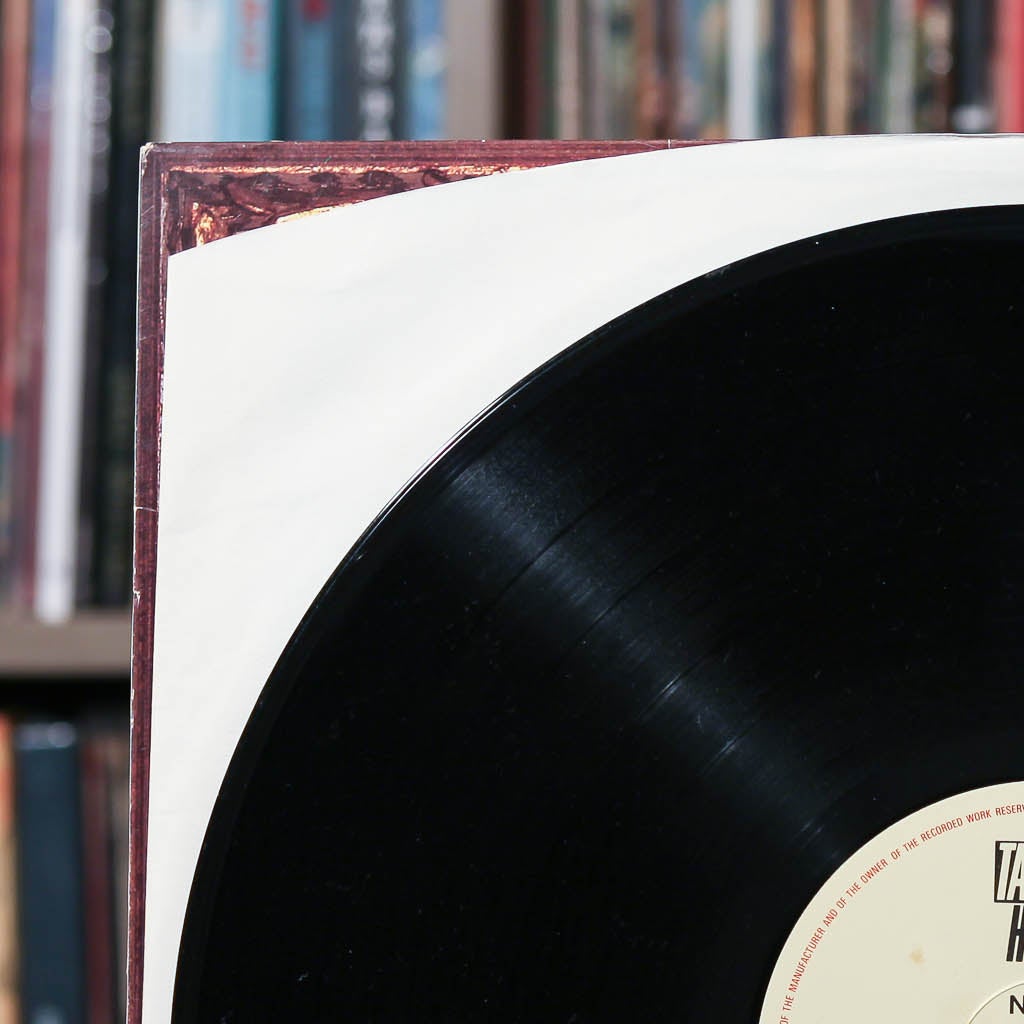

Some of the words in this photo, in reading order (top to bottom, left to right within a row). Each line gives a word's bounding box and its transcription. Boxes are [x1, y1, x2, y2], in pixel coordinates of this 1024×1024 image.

[965, 809, 992, 824] WORK
[919, 817, 964, 842] RECORDED
[902, 838, 920, 852] THE
[890, 848, 901, 861] OF
[860, 858, 889, 884] OWNER
[845, 881, 862, 897] THE
[835, 896, 847, 909] OF
[822, 908, 838, 928] AND
[788, 927, 826, 993] MANUFACTURER
[782, 994, 795, 1011] THE
